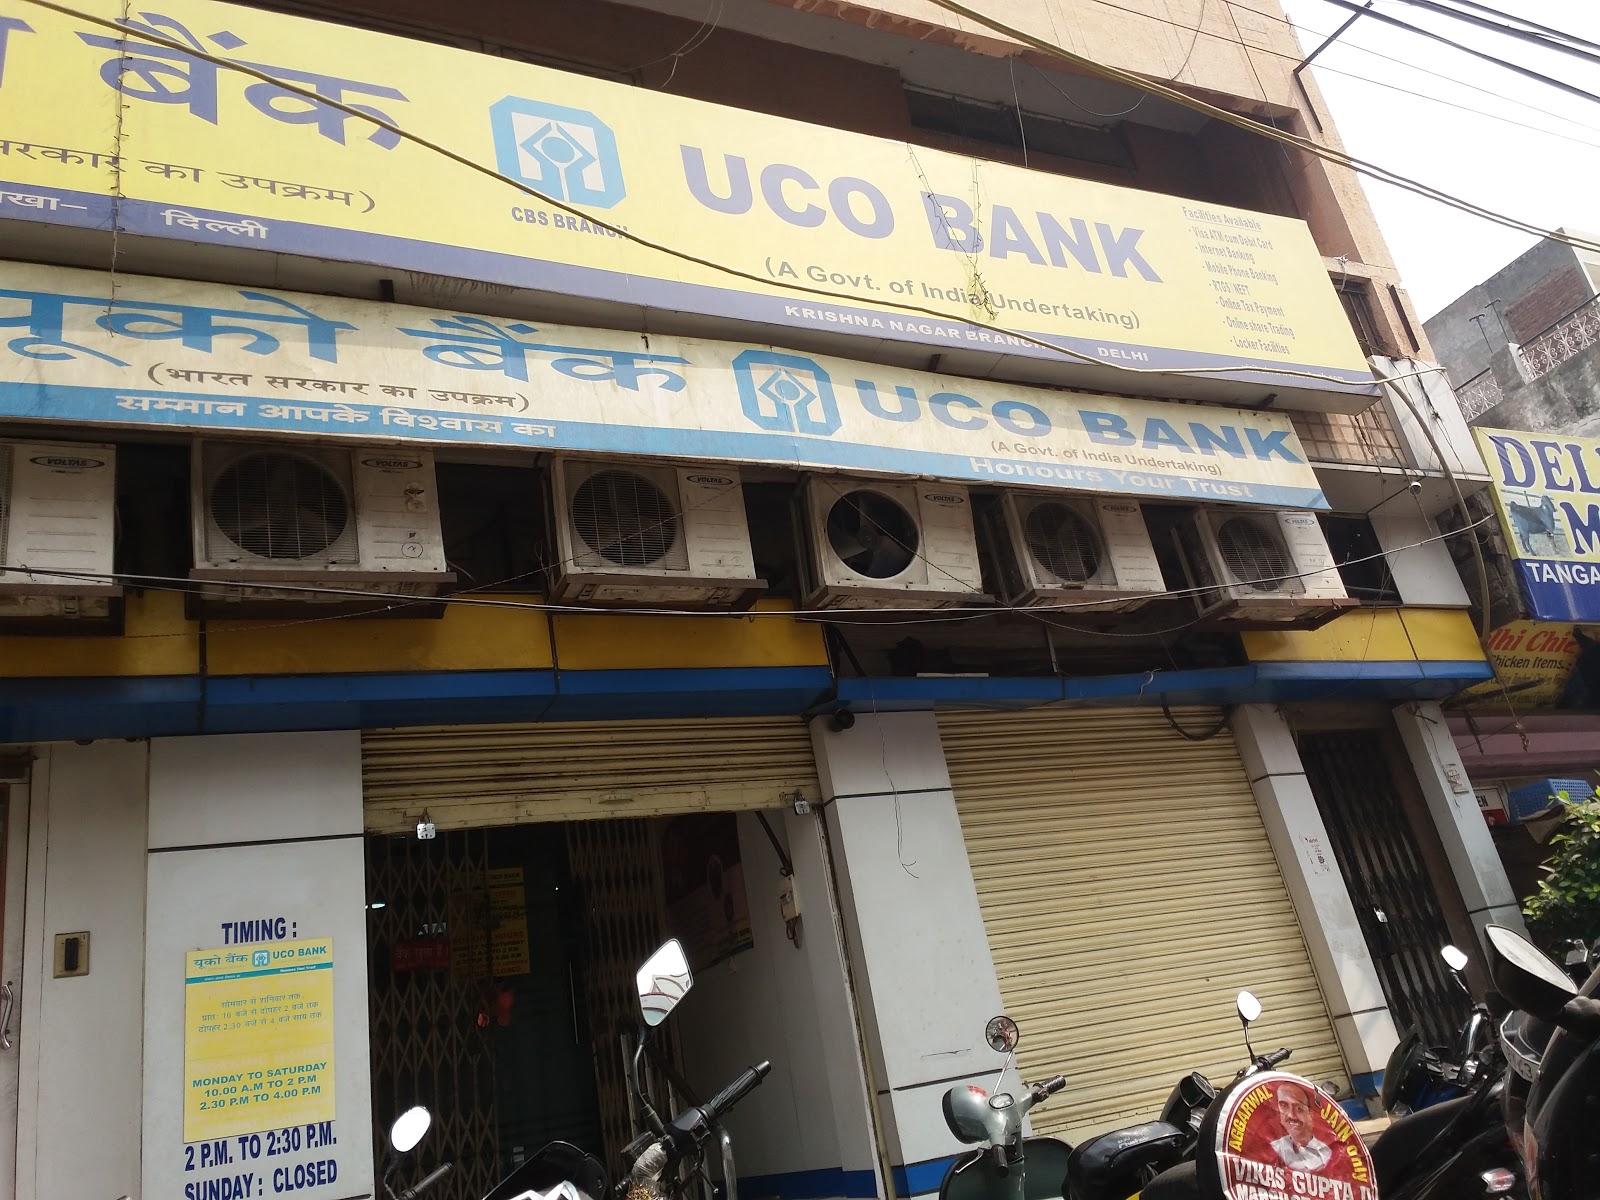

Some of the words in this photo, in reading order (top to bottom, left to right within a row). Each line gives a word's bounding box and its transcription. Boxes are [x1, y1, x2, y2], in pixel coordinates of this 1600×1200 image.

[74, 11, 410, 151] बैंक
[139, 159, 206, 184] का
[216, 171, 376, 214] उपक्रम)
[160, 209, 269, 239] दिल्ली
[511, 206, 549, 226] CBS
[679, 144, 895, 239] UCO
[919, 191, 1164, 284] BANK
[1182, 206, 1222, 223] Facilities
[1223, 214, 1262, 230] Available
[1209, 229, 1224, 241] ATM
[1256, 238, 1273, 250] Card
[1198, 242, 1227, 257] Internet
[1226, 247, 1255, 264] Banking
[1205, 260, 1228, 275] Mobile
[1228, 265, 1250, 278] Phone
[1249, 267, 1278, 285] Banking
[764, 257, 800, 279] (A
[807, 264, 881, 291] Govt.
[888, 279, 915, 296] of
[922, 283, 986, 307] India
[990, 292, 1140, 330] Undertaking)
[1219, 296, 1241, 310] Online
[1240, 300, 1255, 312] Tax
[1254, 301, 1285, 317] Payment
[784, 305, 885, 330] KRISHNA
[890, 320, 961, 340] NAGAR
[1097, 346, 1149, 362] DELHI
[1226, 316, 1249, 330] Online
[1249, 320, 1269, 333] share
[1268, 322, 1295, 340] Trading
[396, 315, 692, 393] बैंक
[1233, 336, 1259, 350] Locker
[1258, 339, 1290, 354] Facilities
[147, 362, 252, 387] (भारत
[265, 374, 370, 396] सरकार
[379, 385, 417, 400] का
[428, 389, 530, 413] उपक्रम)
[115, 395, 247, 417] सम्मान
[258, 402, 370, 424] आपके
[379, 407, 503, 434] विश्वास
[511, 422, 557, 438] का
[854, 378, 1052, 438] UCO
[1077, 409, 1304, 465] BANK
[47, 458, 87, 467] VOLTAS
[376, 460, 408, 468] VOLTAS
[990, 439, 1011, 455] (A
[1013, 441, 1059, 459] Govt.
[1062, 446, 1079, 460] of
[1082, 449, 1122, 465] India
[1126, 454, 1222, 477] Undertaking)
[697, 476, 722, 484] VOLTAS
[969, 456, 1103, 484] Honours
[1110, 468, 1175, 490] Your
[1185, 476, 1253, 498] Trust
[221, 917, 287, 945] TIMING
[193, 955, 221, 968] यूको
[225, 952, 249, 964] बैंक
[272, 949, 295, 960] UCO
[297, 945, 327, 957] BANK
[221, 999, 247, 1009] सोमवार
[235, 1009, 247, 1017] बजे
[260, 1005, 281, 1014] दोपहर
[291, 1002, 303, 1010] बजे
[198, 1024, 220, 1033] दोपहर
[223, 1022, 241, 1031] 2.30
[245, 1019, 257, 1027] बजे
[278, 1015, 290, 1023] बजे
[192, 1073, 243, 1088] MONDAY
[247, 1071, 263, 1080] TO
[267, 1062, 328, 1077] SATURDAY
[204, 1086, 237, 1098] 10.00
[240, 1082, 263, 1093] A.M
[267, 1079, 283, 1089] TO
[287, 1078, 294, 1087] 2
[297, 1074, 317, 1085] P.M
[199, 1099, 226, 1111] 2.30
[229, 1096, 249, 1106] P.M
[253, 1093, 270, 1103] TO
[273, 1089, 298, 1100] 4.00
[302, 1085, 321, 1096] P.M
[184, 1145, 195, 1172] 2
[200, 1140, 233, 1169] P.M.
[238, 1134, 261, 1161] TO
[266, 1125, 301, 1157] 2:30
[306, 1121, 337, 1149] P.M.
[1229, 1085, 1273, 1152] AGGARWAL
[1320, 1103, 1353, 1143] JAIN
[1346, 1144, 1368, 1183] only
[184, 1172, 254, 1200] SUNDAY
[273, 1159, 338, 1193] CLOSED
[1232, 1157, 1285, 1190] VIKAS
[1291, 1171, 1357, 1200] GUPTA
